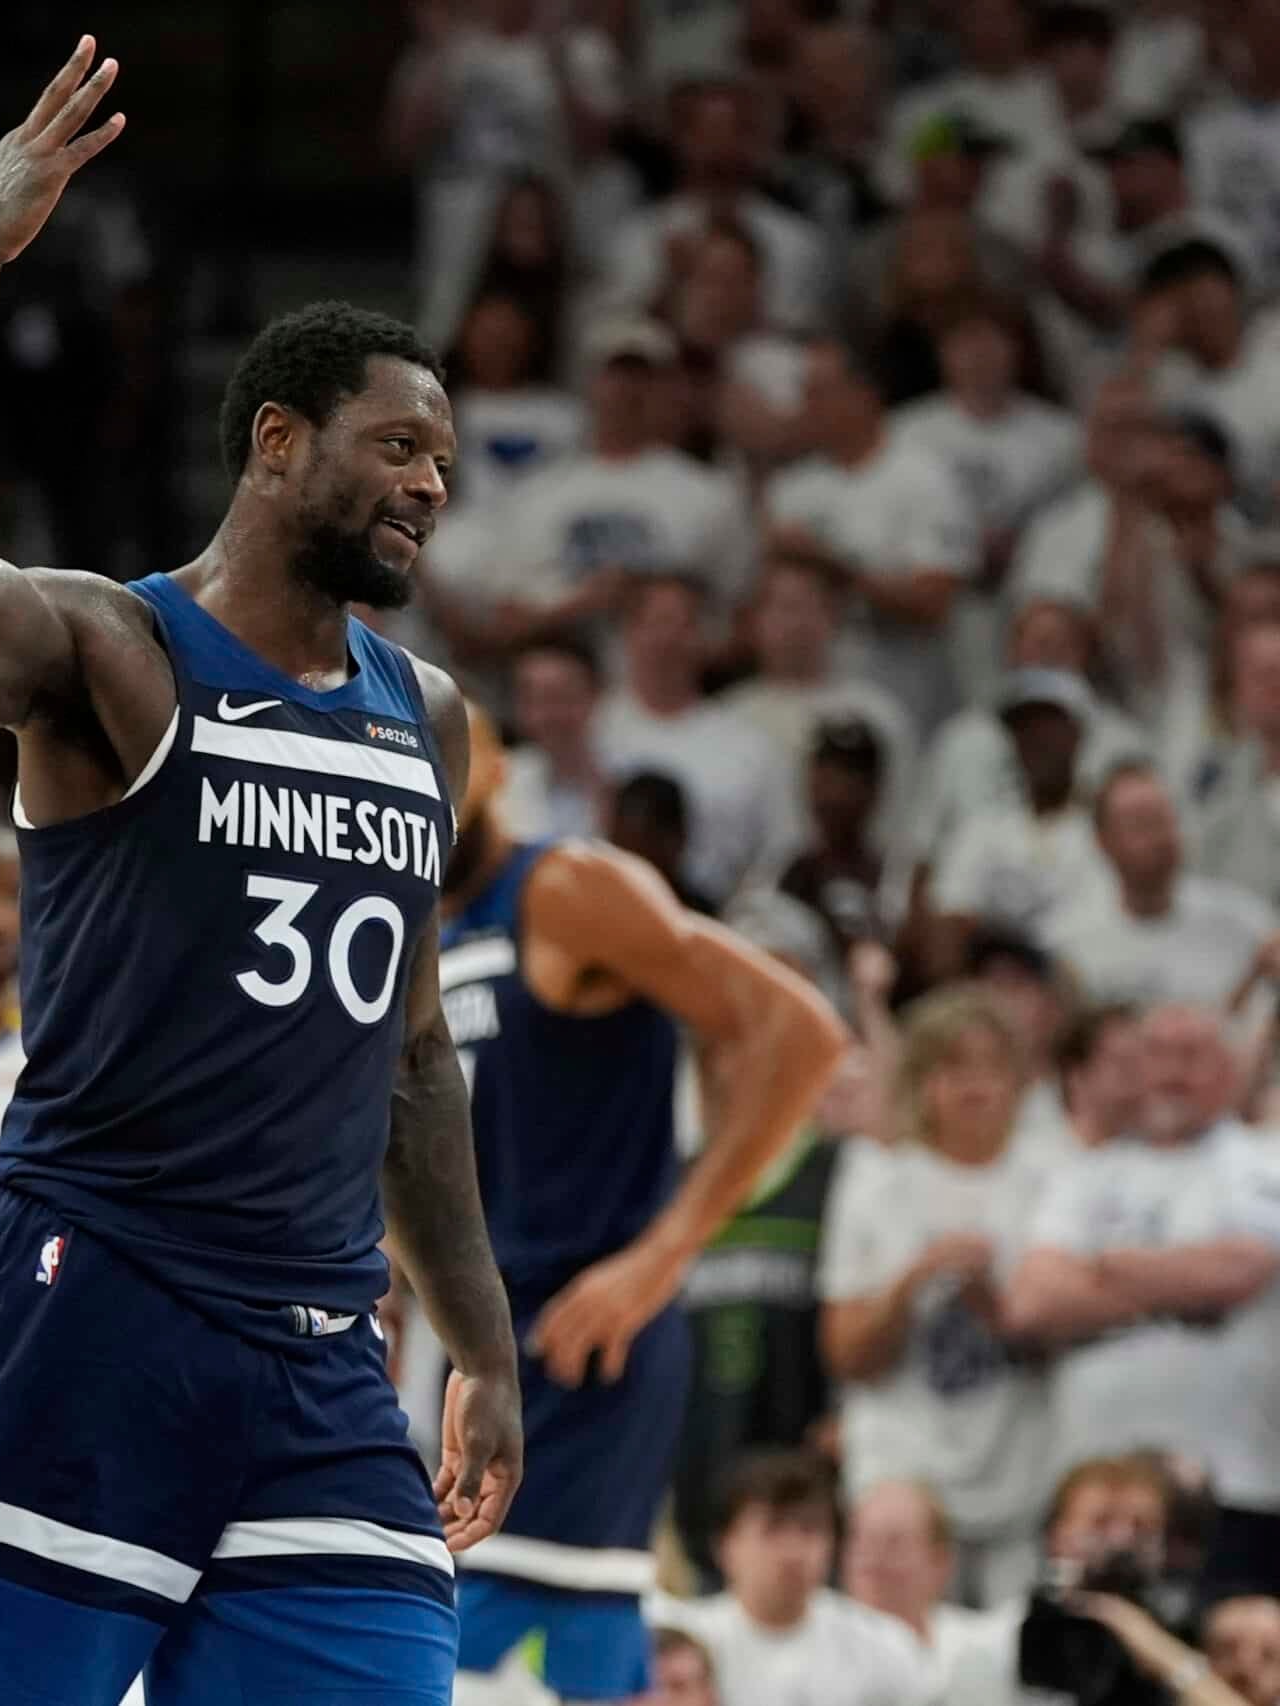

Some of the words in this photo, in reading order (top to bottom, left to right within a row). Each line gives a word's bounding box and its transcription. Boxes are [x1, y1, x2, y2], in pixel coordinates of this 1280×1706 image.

[376, 727, 418, 748] sezzle
[198, 776, 440, 887] MINNESOTA
[236, 874, 404, 1024] 30
